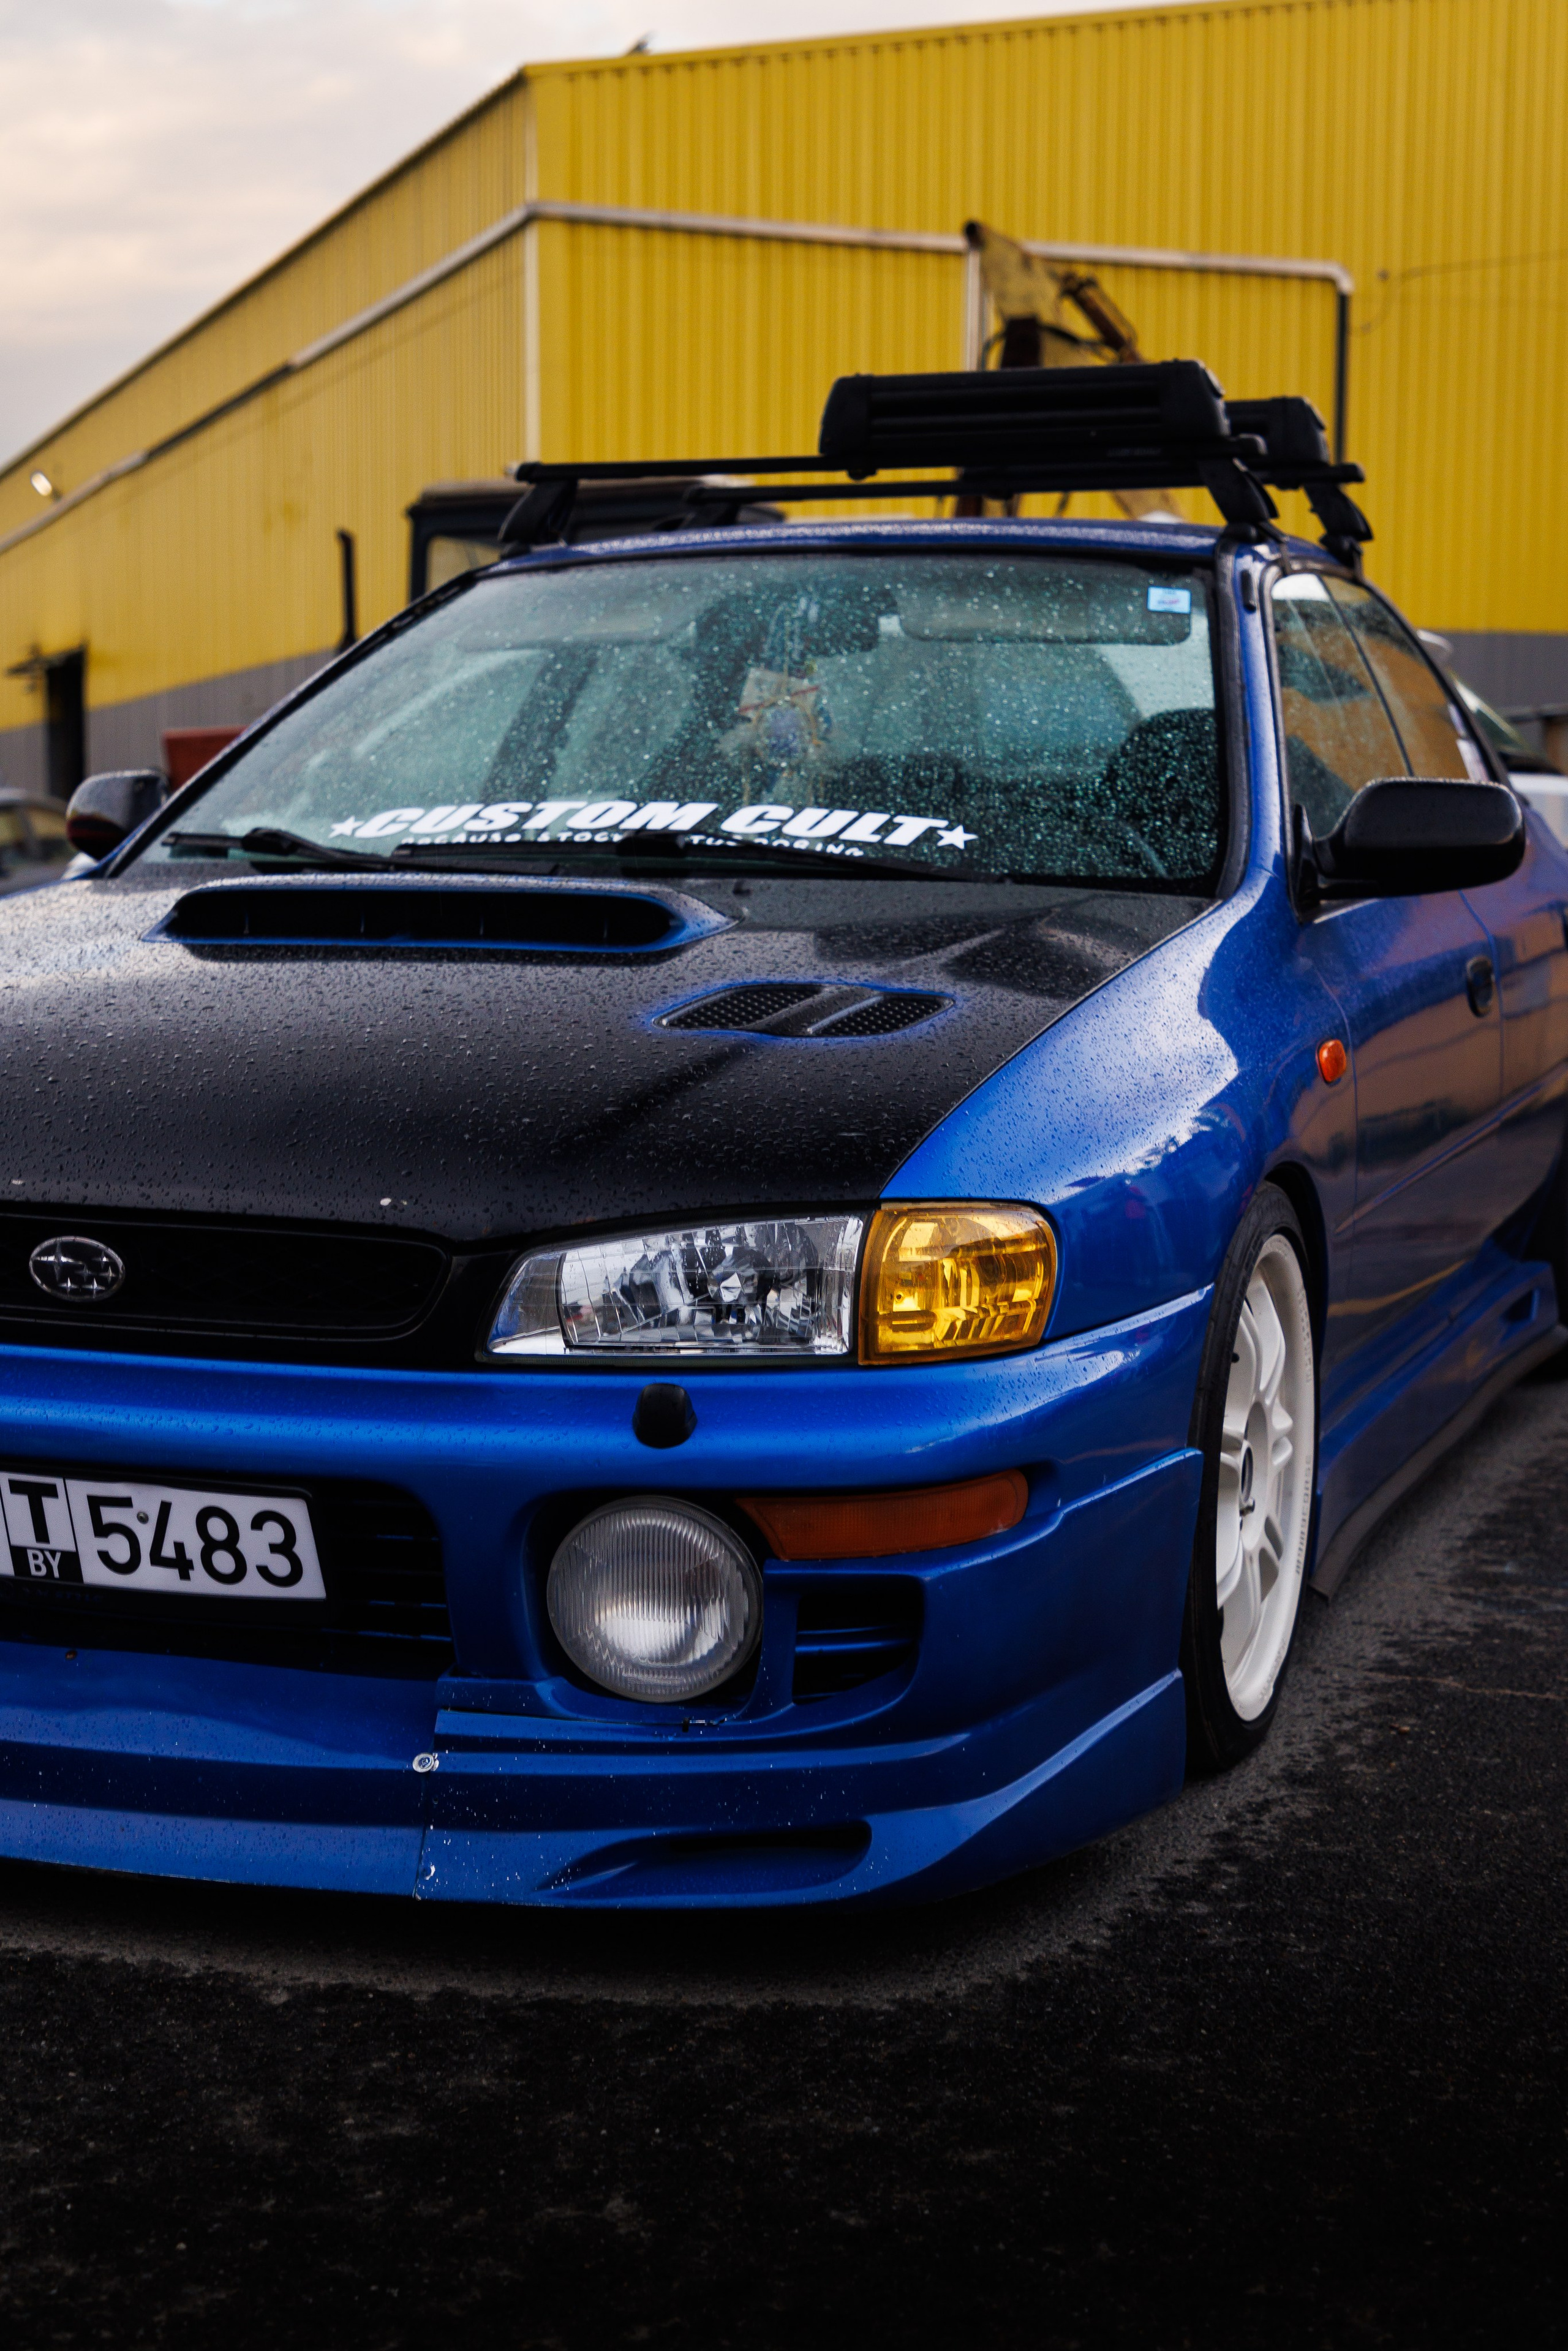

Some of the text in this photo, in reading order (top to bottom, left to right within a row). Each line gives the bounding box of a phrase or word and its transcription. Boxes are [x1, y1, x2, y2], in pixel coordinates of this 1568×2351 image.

[353, 800, 949, 845] CUSTOM CULT
[7, 1478, 304, 1588] T 5483
[27, 1549, 62, 1579] BY
